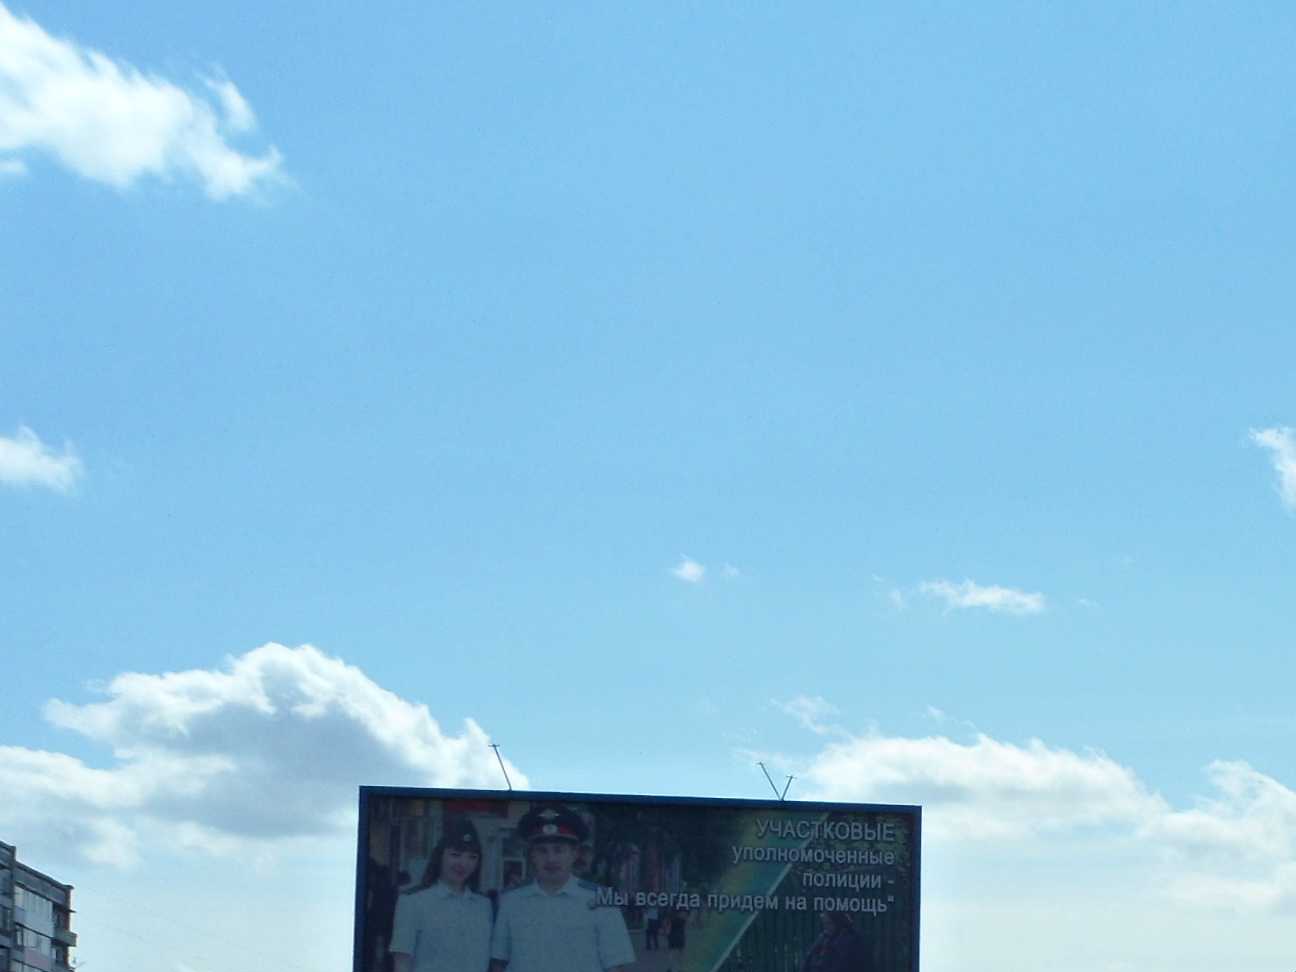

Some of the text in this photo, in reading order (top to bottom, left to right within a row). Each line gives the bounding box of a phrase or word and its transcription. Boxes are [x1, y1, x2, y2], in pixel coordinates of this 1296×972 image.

[756, 819, 896, 842] УЧАСТКОВЫЕ
[731, 845, 896, 866] уполномоченные
[802, 871, 882, 891] полиции
[596, 886, 629, 906] Мы
[635, 890, 700, 911] всегда
[706, 893, 778, 913] придем
[784, 895, 807, 911] на
